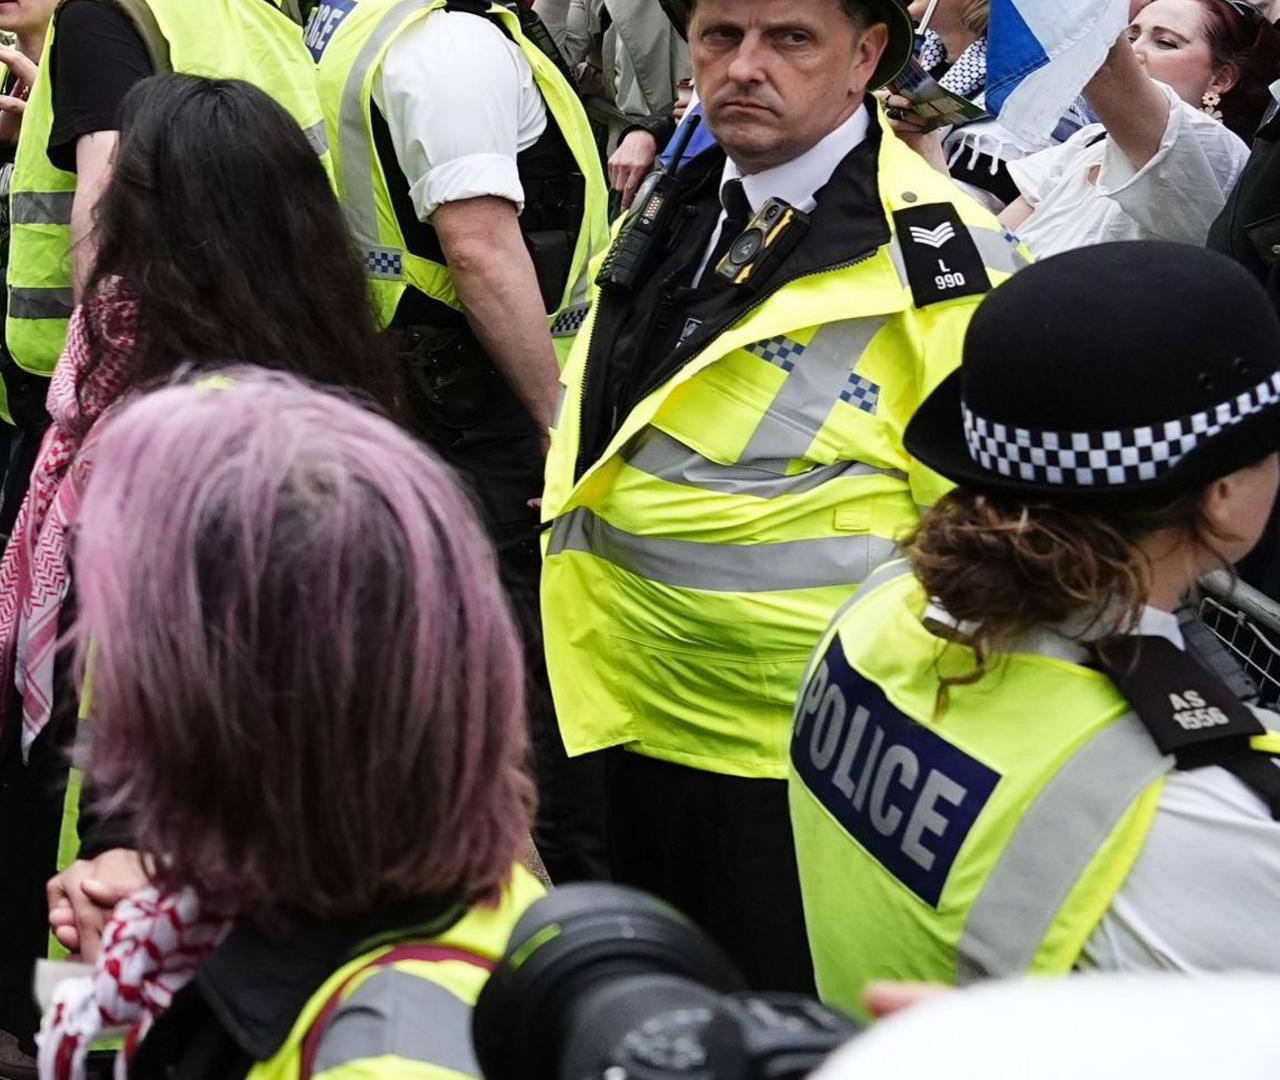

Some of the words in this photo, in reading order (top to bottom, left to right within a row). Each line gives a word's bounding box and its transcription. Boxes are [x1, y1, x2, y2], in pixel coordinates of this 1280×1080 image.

[939, 258, 950, 273] L
[934, 272, 966, 290] 990
[1168, 690, 1206, 711] AS
[795, 658, 968, 872] POLICE
